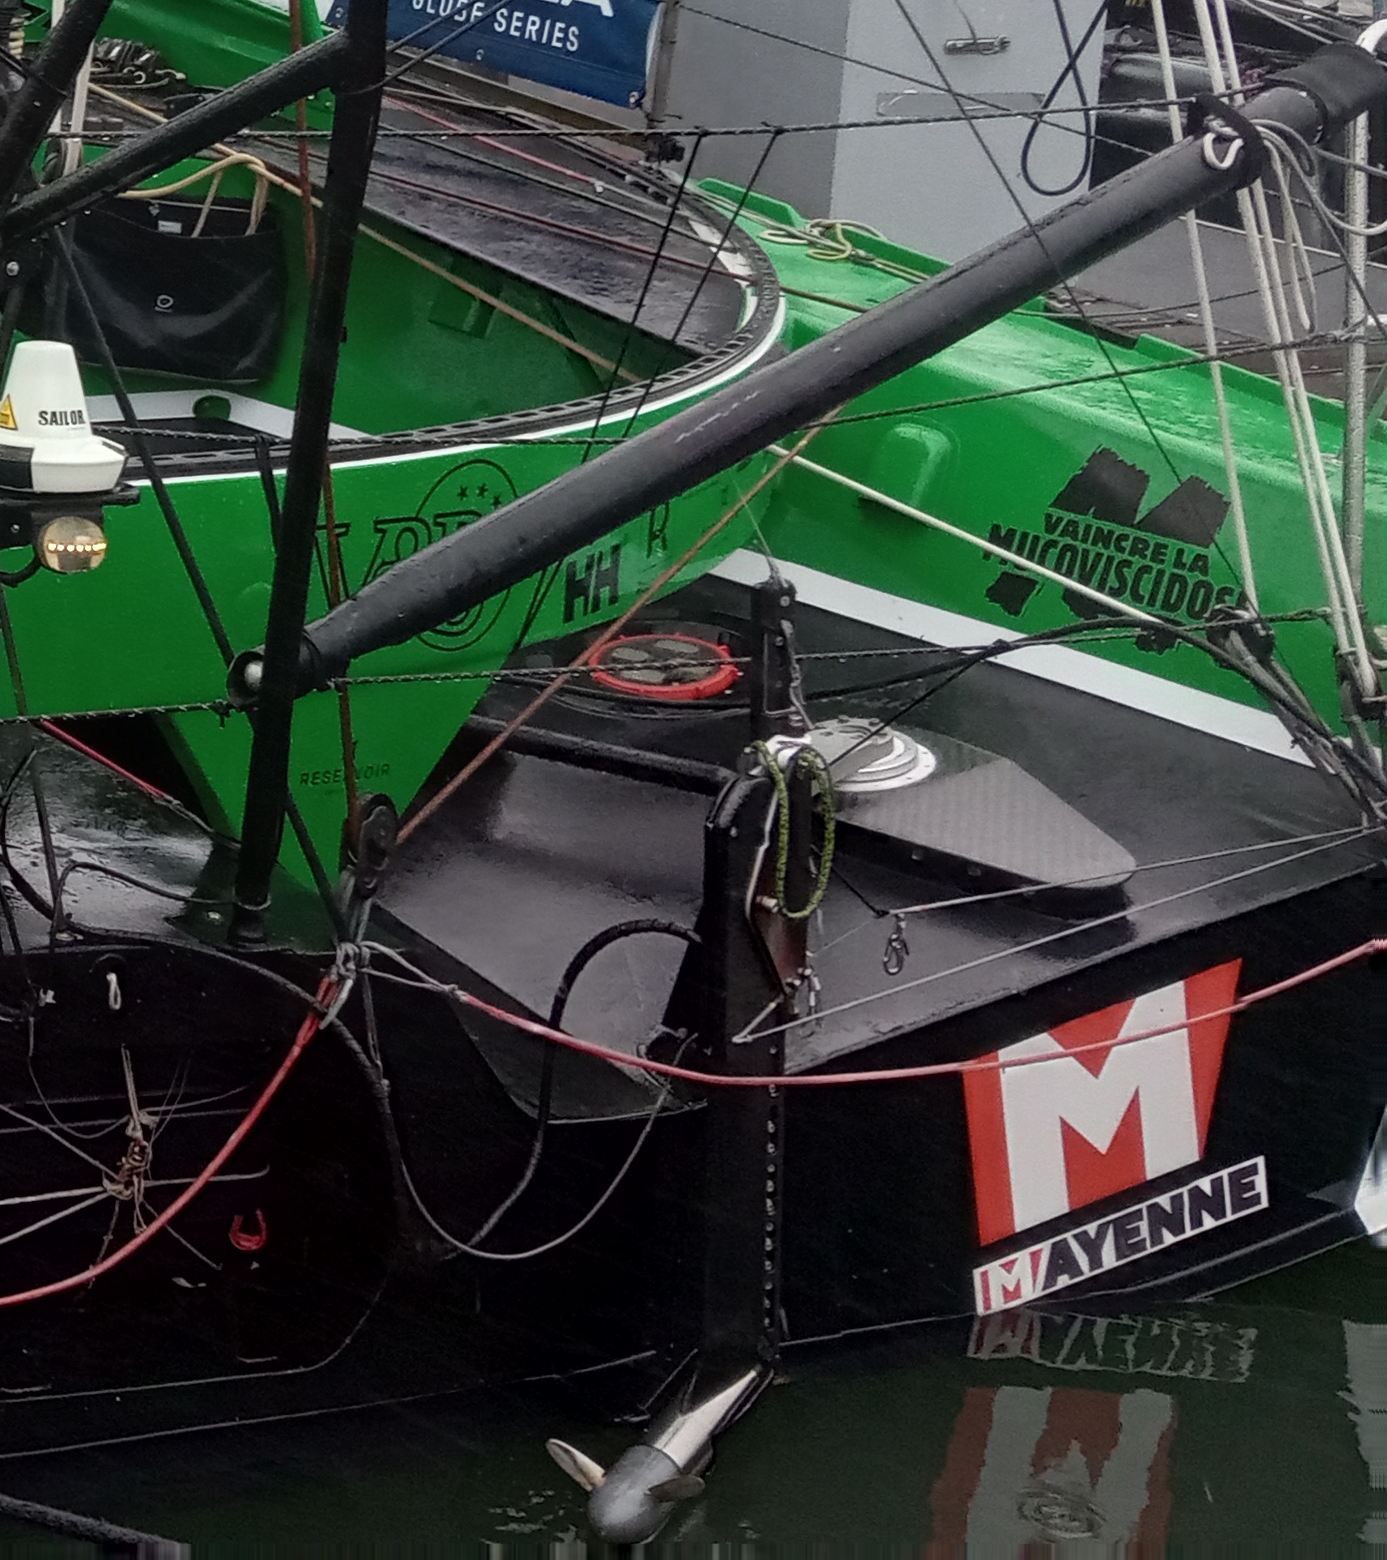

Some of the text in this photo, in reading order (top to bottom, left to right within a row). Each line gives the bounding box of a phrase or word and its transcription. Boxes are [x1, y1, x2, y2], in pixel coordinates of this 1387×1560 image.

[493, 8, 581, 53] SERIES
[37, 409, 86, 427] SAILOR
[1042, 511, 1211, 578] VAINCRE LA
[980, 1161, 1264, 1313] MAYENNE
